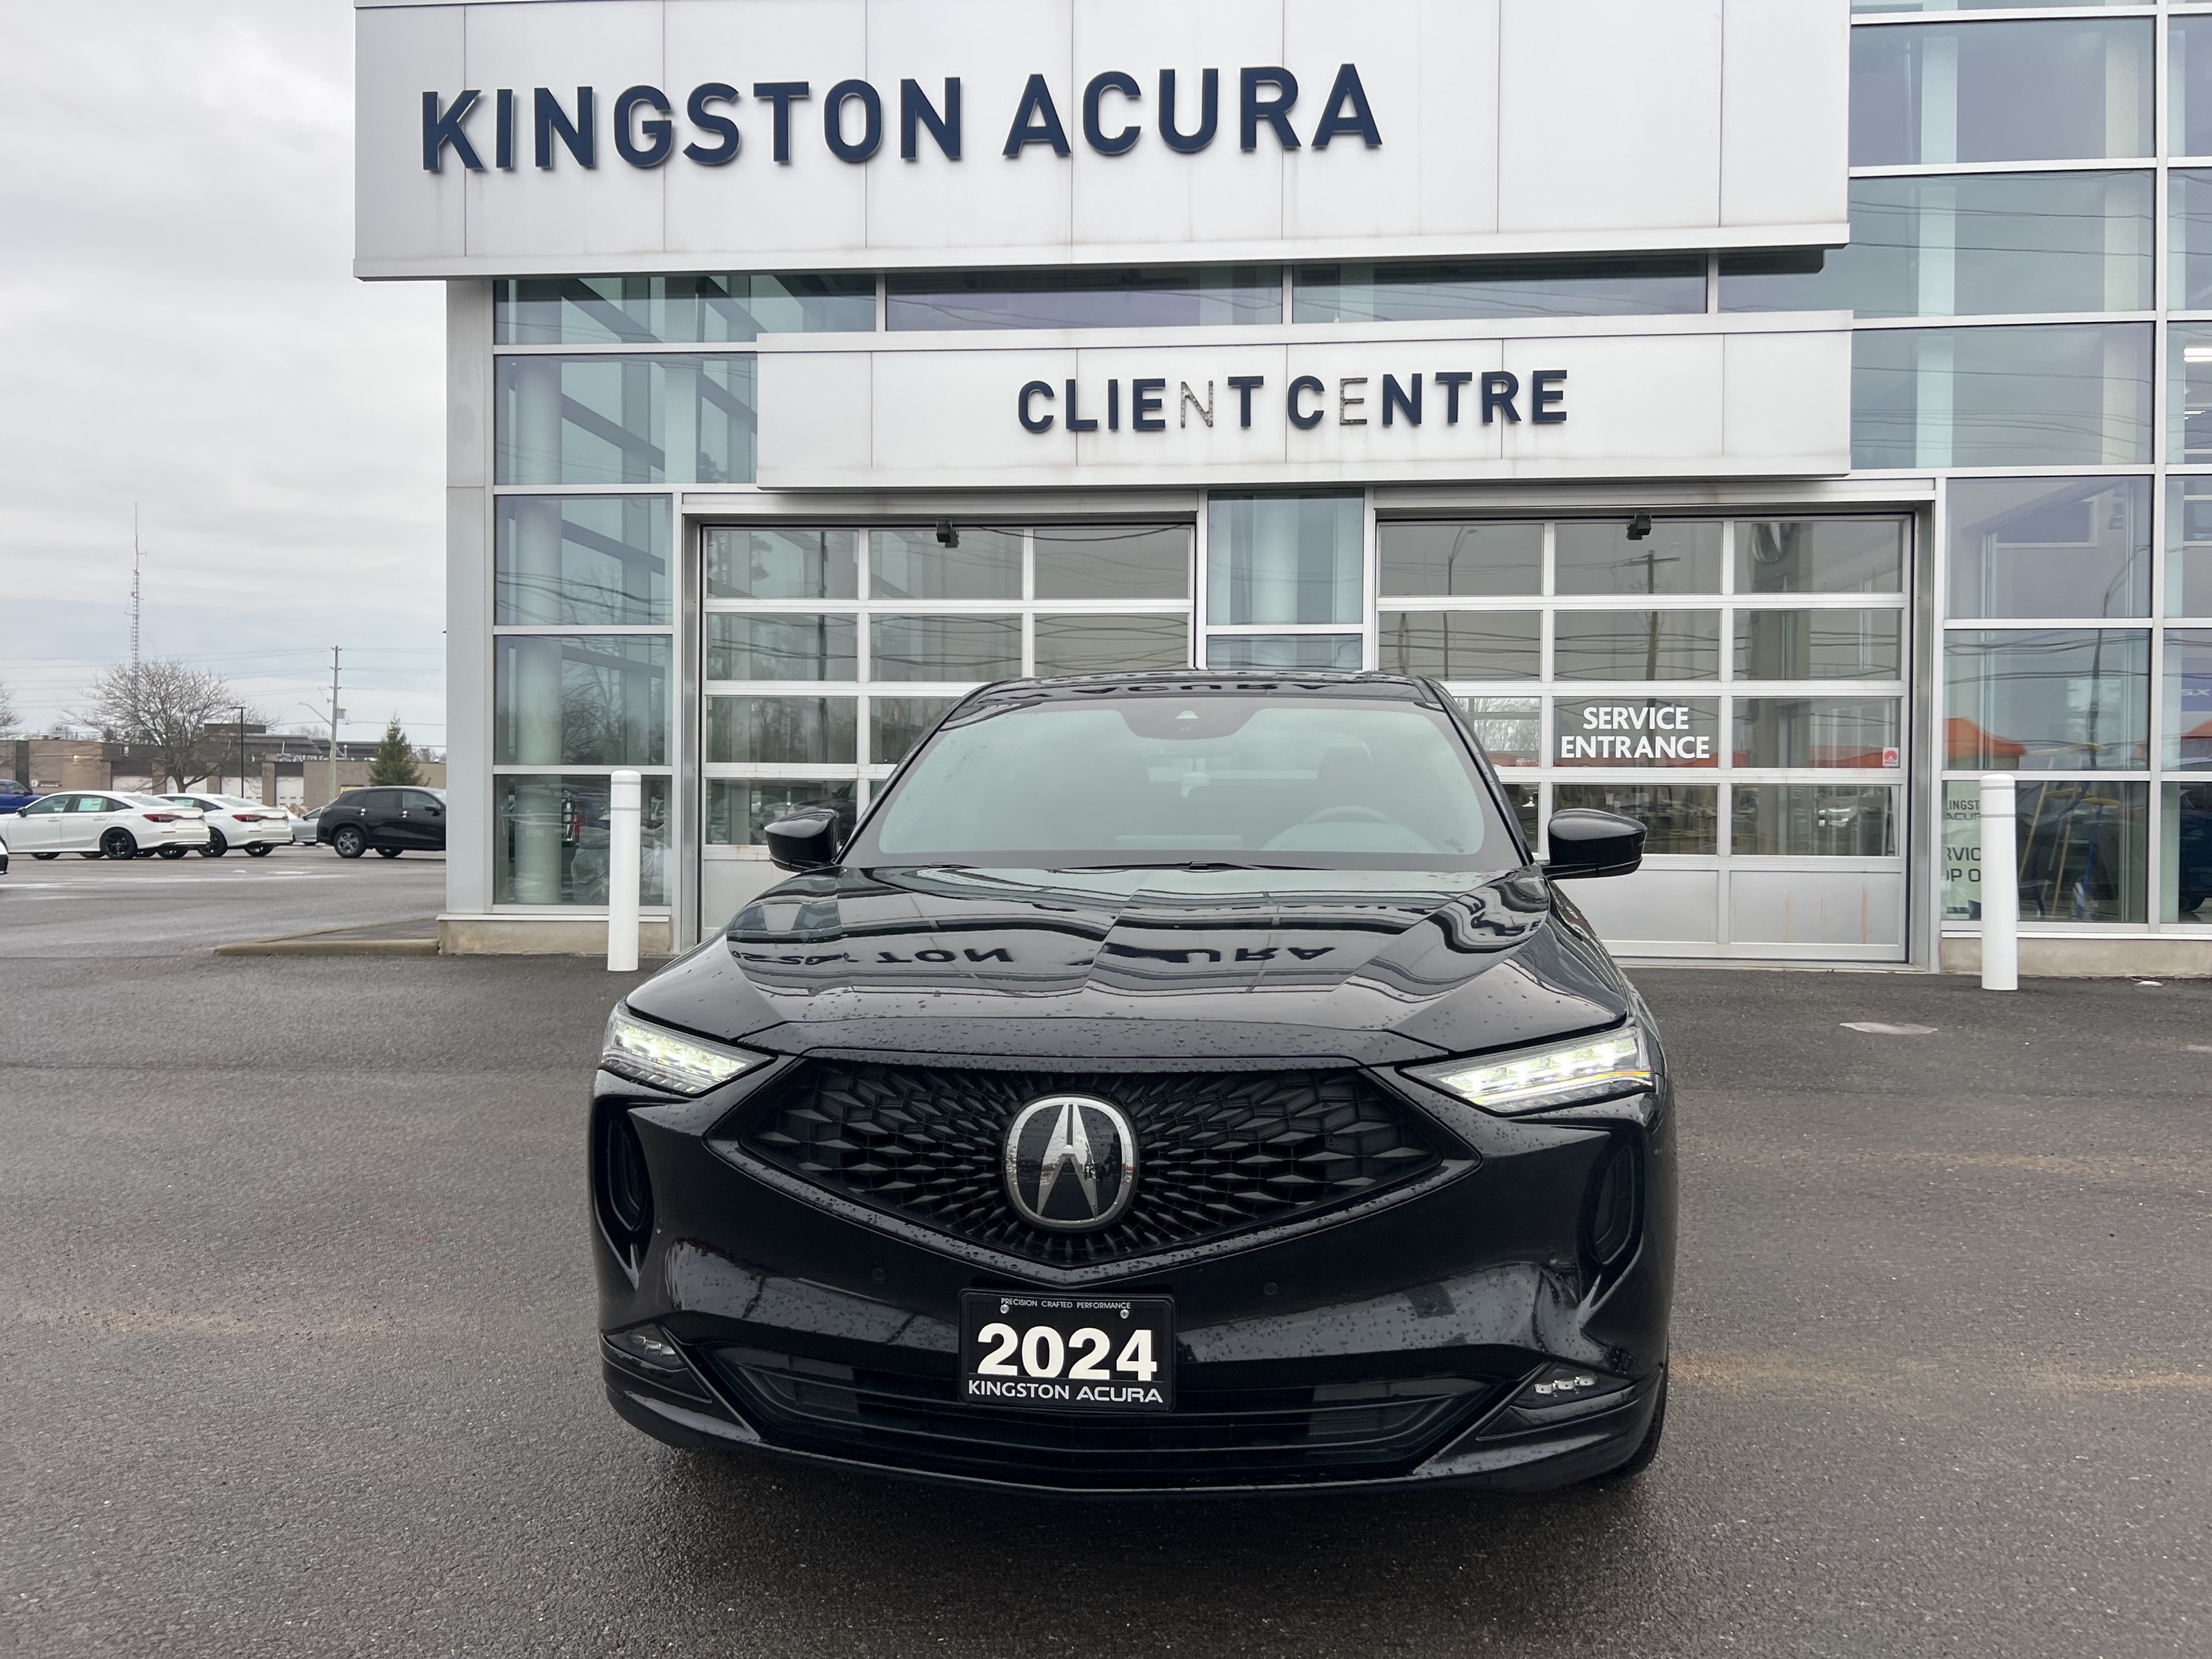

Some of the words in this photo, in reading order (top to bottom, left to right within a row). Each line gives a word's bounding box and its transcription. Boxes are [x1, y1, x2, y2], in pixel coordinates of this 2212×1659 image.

[422, 78, 961, 174] KINGSTON
[1002, 63, 1382, 160] ACURA
[1018, 376, 1264, 434] CLIENT
[1287, 370, 1568, 431] CENTRE
[1582, 707, 1689, 730] SERVICE
[1561, 736, 1710, 759] ENTRANCE
[1947, 800, 1980, 810] INGST
[1001, 1297, 1038, 1306] PRECISION
[977, 1323, 1157, 1382] 2024
[969, 1380, 1069, 1399] KINGSTON
[1076, 1386, 1164, 1403] ACURA
